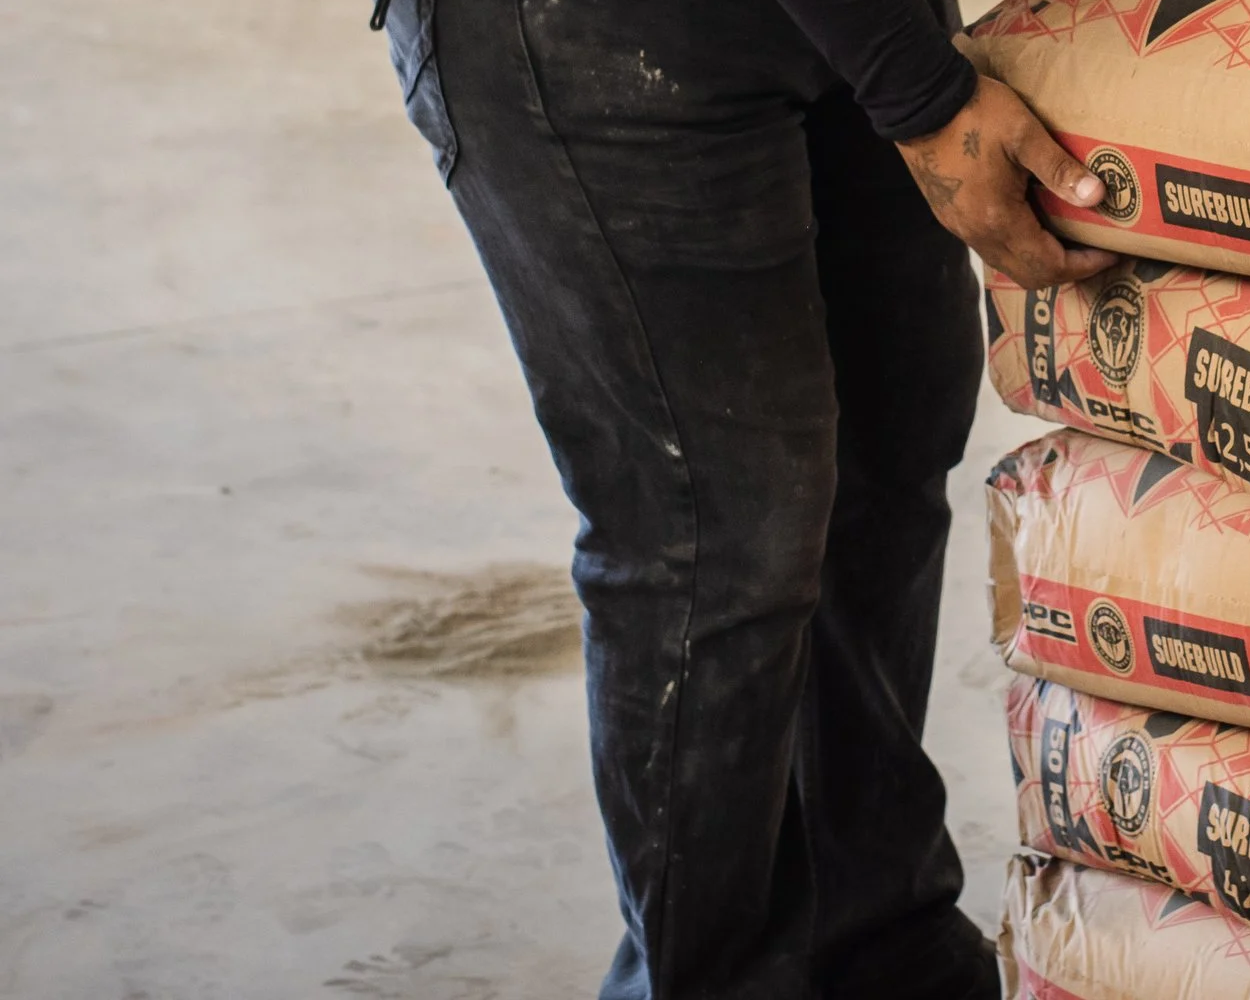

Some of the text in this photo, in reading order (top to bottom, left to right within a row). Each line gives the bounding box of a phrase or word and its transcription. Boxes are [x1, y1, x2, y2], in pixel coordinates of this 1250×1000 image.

[1030, 332, 1051, 378] kg
[1023, 602, 1073, 630] PC
[1151, 633, 1246, 684] SUREBUILD
